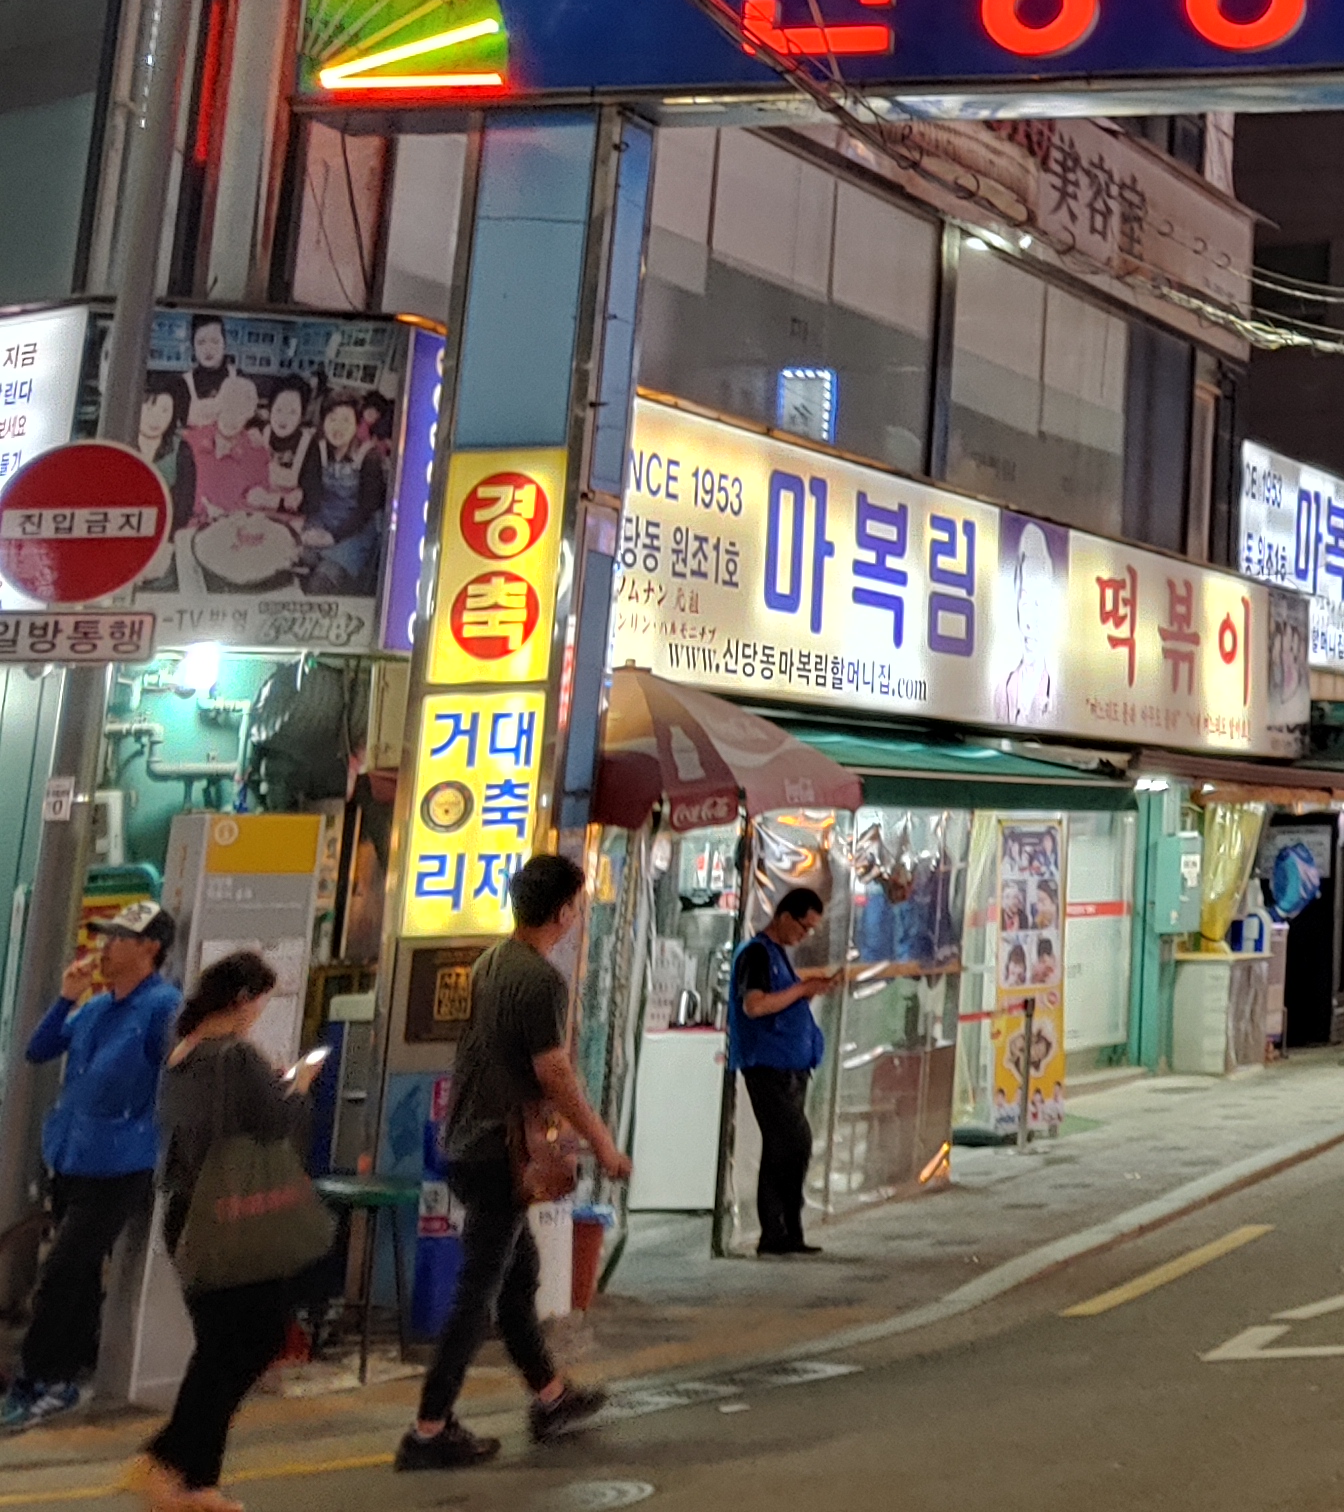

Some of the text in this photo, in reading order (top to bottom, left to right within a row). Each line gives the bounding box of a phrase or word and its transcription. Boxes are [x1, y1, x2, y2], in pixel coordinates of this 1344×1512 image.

[3, 342, 38, 369] 지금
[0, 378, 33, 406] 린다
[692, 466, 743, 516] 1953
[1262, 471, 1283, 509] 1953
[19, 511, 143, 536] 진입금지
[762, 468, 1252, 707] 마복림 떡볶이
[0, 619, 145, 655] 일방통행
